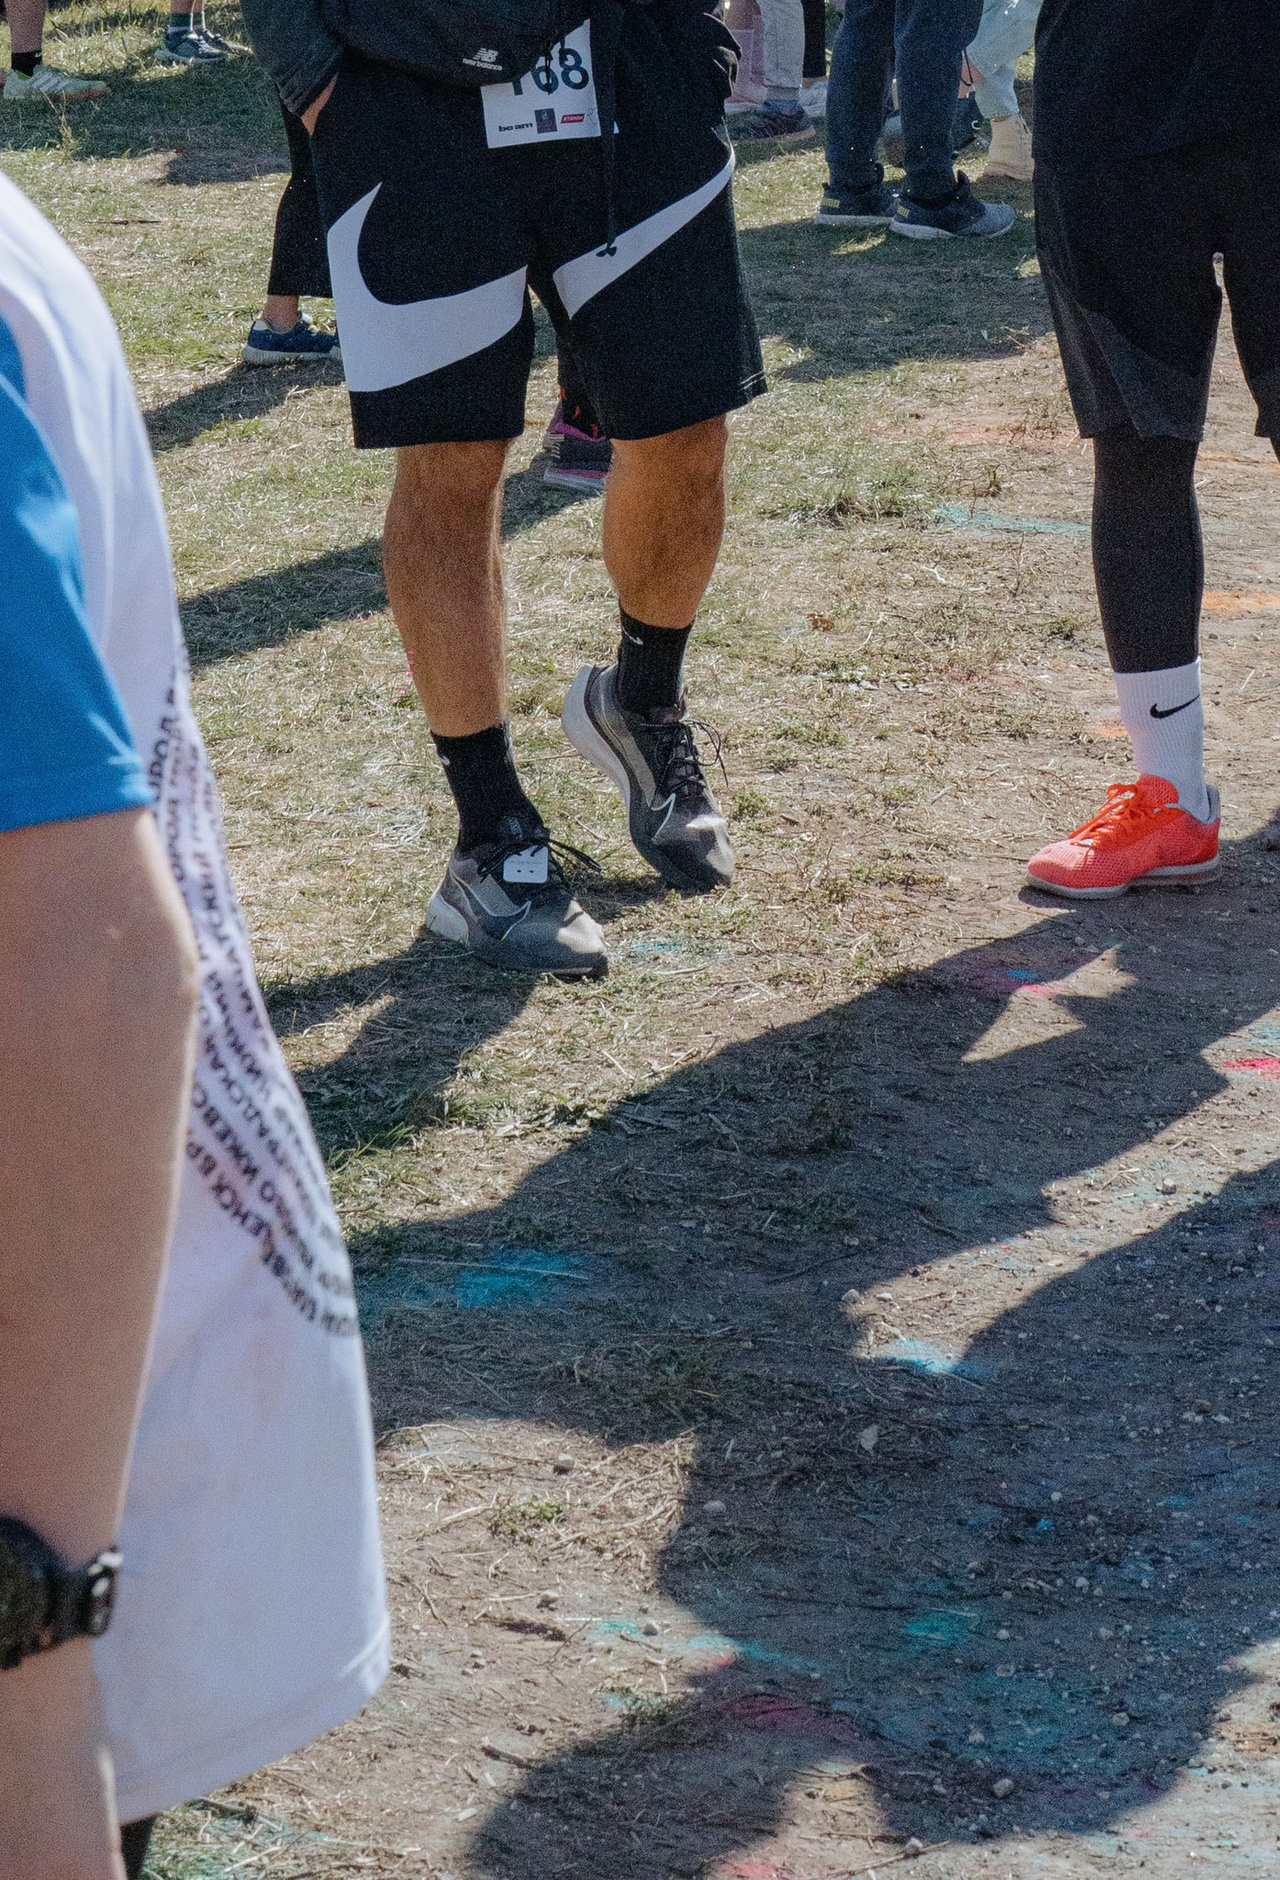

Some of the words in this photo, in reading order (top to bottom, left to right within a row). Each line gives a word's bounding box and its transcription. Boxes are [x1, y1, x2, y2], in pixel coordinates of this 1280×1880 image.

[462, 58, 477, 66] new
[476, 60, 503, 71] balance
[190, 1082, 261, 1184] ИЖЕВС
